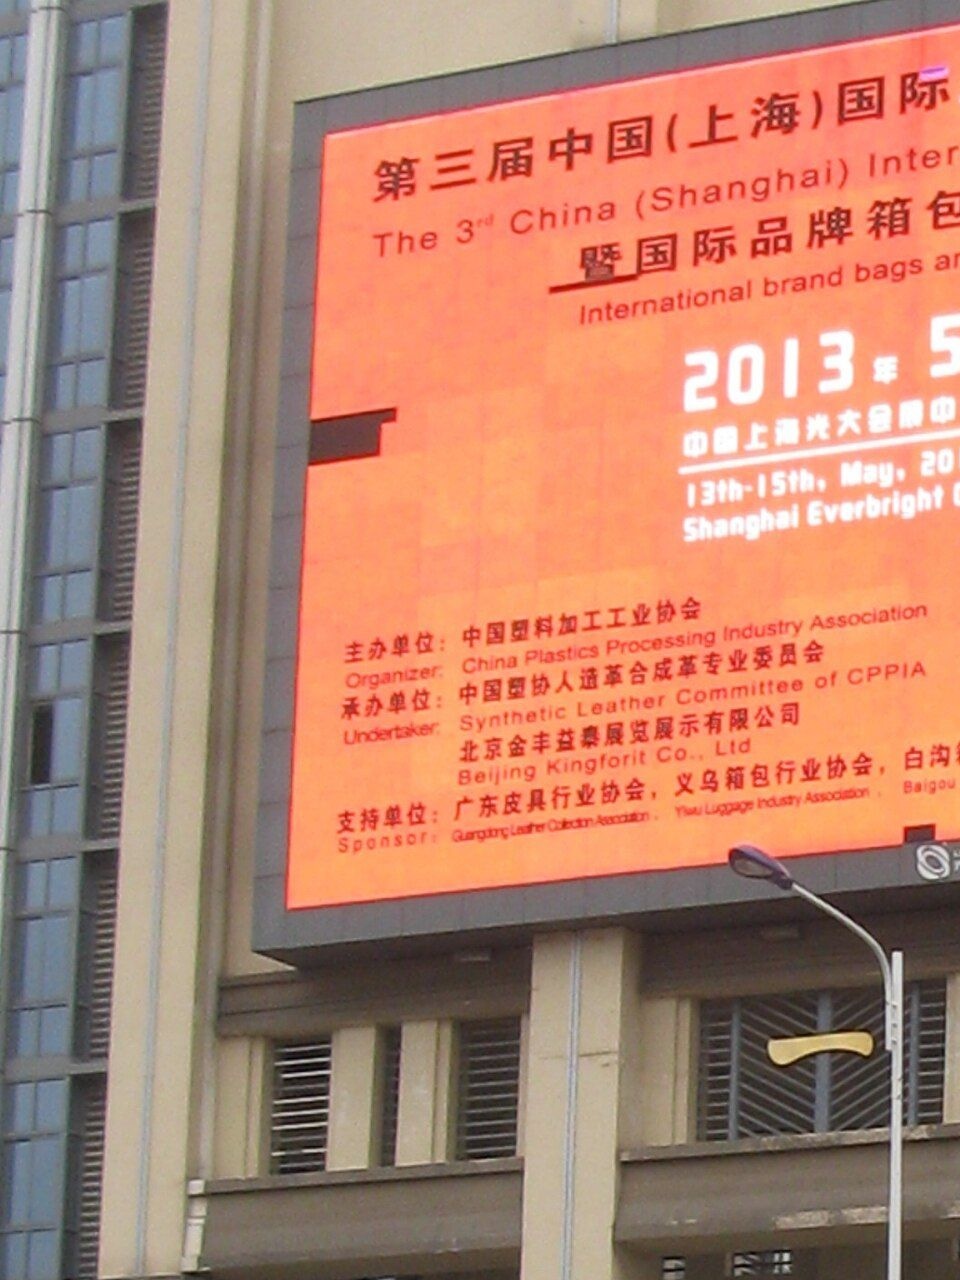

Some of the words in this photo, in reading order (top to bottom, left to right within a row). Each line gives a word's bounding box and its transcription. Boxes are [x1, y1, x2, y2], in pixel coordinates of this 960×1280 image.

[372, 231, 439, 257] The
[456, 213, 495, 244] 3rd
[510, 201, 616, 235] China
[635, 157, 848, 221] (Shanghai)
[579, 280, 752, 325] International
[763, 266, 844, 297] brand
[855, 257, 923, 284] bags
[683, 503, 800, 543] Shanghai
[806, 483, 944, 527] Everbright
[461, 655, 518, 675] China
[524, 644, 600, 667] Plastics
[606, 629, 716, 657] Processing
[723, 618, 802, 643] Industry
[809, 603, 927, 631] Association
[462, 596, 701, 648] 中国塑料加工工业协会
[460, 704, 567, 733] Synthetic
[577, 694, 665, 718] Leather
[676, 678, 803, 706] Committee
[815, 671, 837, 690] of
[847, 660, 927, 686] CPPIA
[458, 762, 536, 786] Beijing
[715, 737, 751, 757] Ltd
